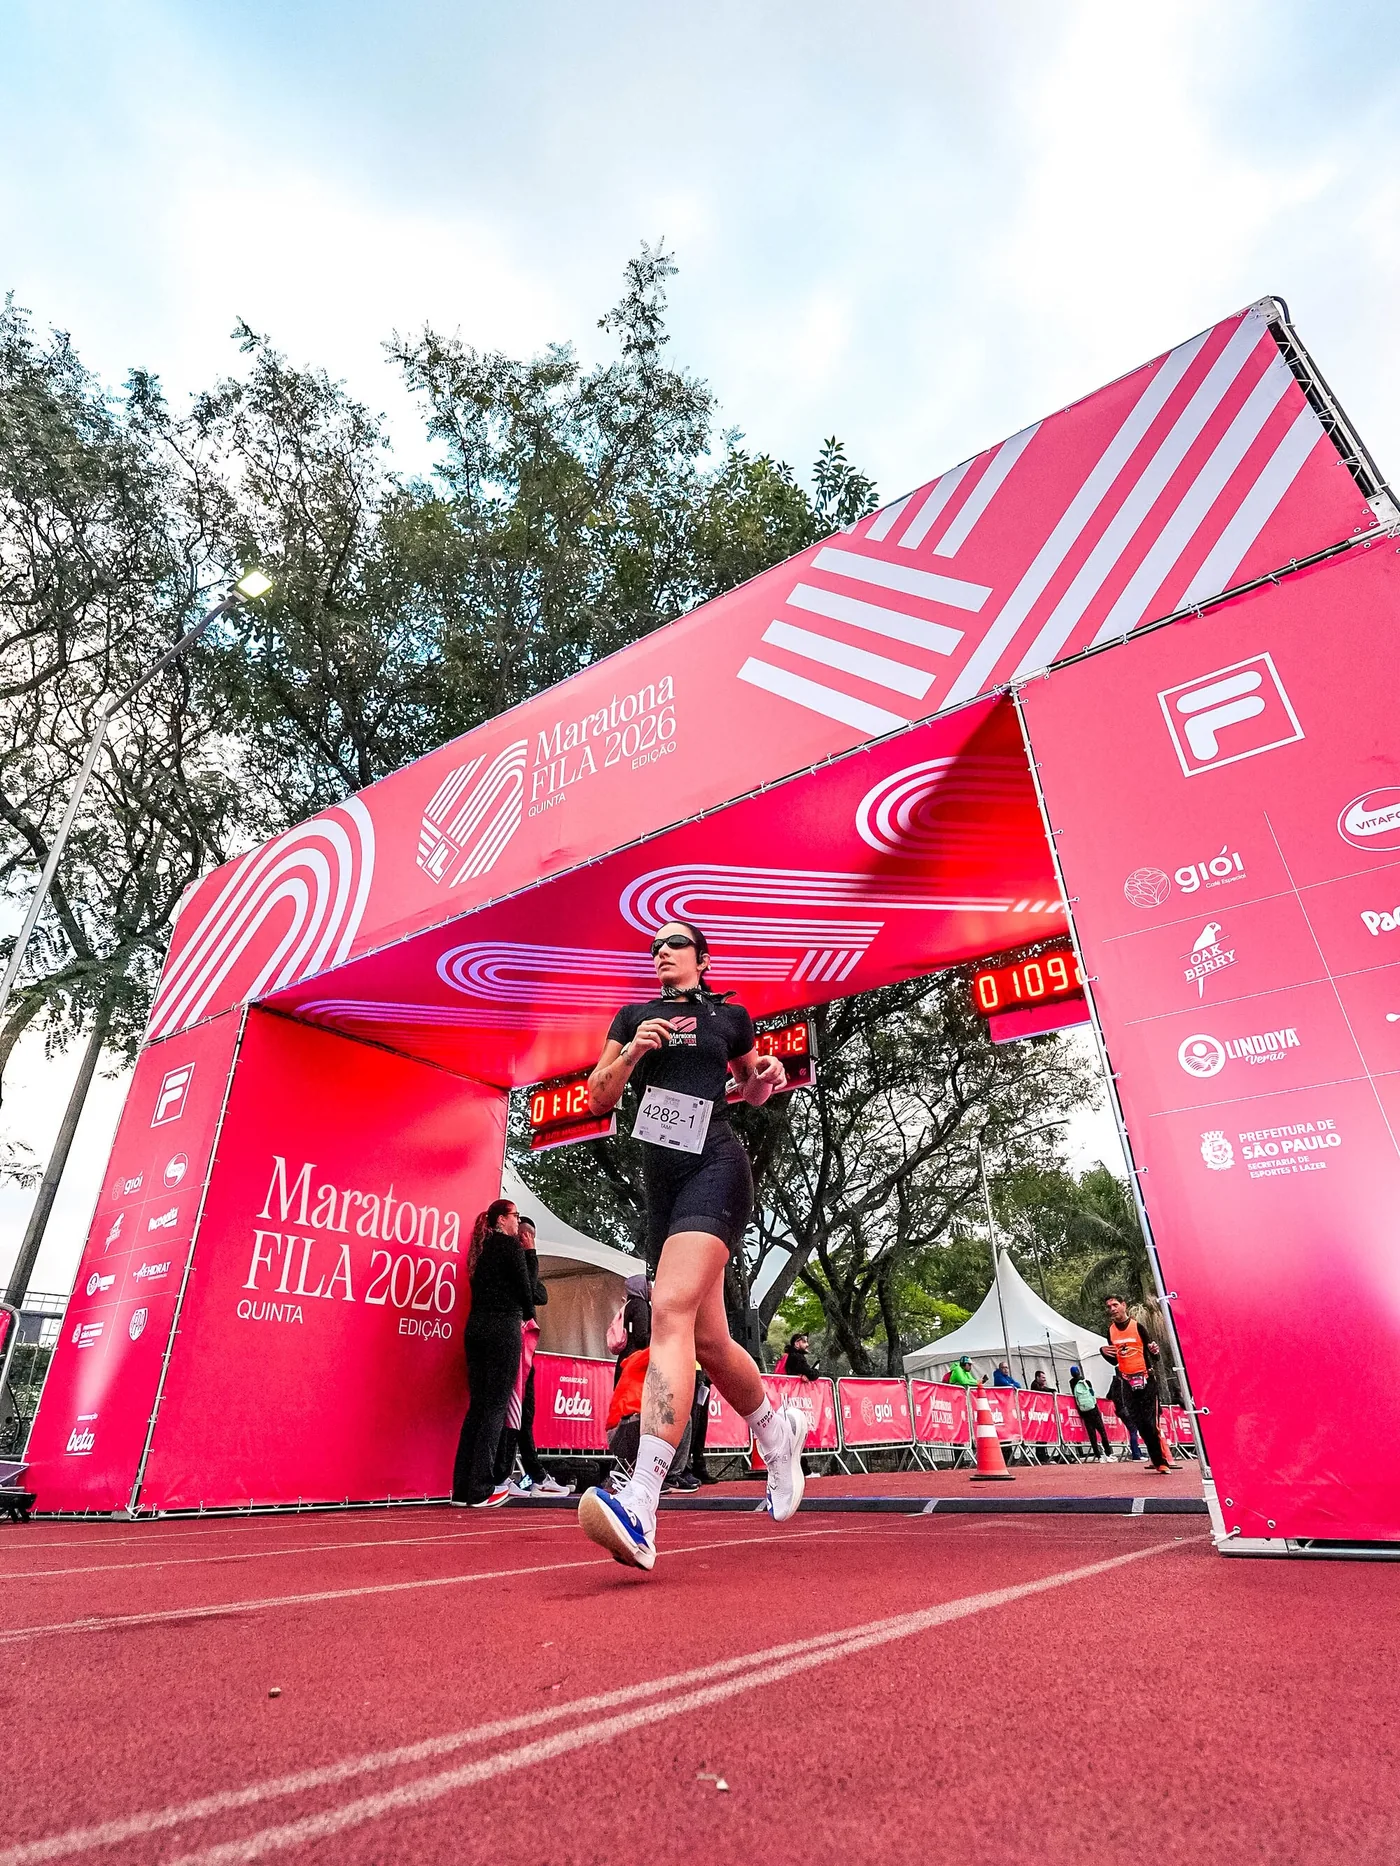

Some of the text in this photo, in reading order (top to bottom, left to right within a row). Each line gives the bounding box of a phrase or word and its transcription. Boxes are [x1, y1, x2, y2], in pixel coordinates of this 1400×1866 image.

[533, 675, 675, 766] Maratona
[530, 704, 677, 804] FILA 2026
[630, 740, 677, 770] EDIÇÃO
[528, 792, 566, 817] QUINTA
[1183, 949, 1236, 981] BERRY
[1190, 943, 1223, 965] OAK
[1224, 1027, 1301, 1059] LINDOYA
[1245, 1050, 1287, 1065] Verão
[642, 1103, 696, 1130] 4282-1
[1238, 1119, 1337, 1143] PREFEITURA DE
[1241, 1133, 1342, 1160] SÃO PAULO
[1247, 1155, 1310, 1171] SECRETARIA DE
[1249, 1161, 1327, 1179] ESPORTES E LAZER
[256, 1155, 460, 1253] Maratona
[241, 1229, 457, 1314] FILA 2026
[236, 1299, 304, 1324] QUINTA
[398, 1317, 452, 1341] EDIÇÃO
[554, 1388, 593, 1417] beta
[66, 1427, 96, 1452] beta
